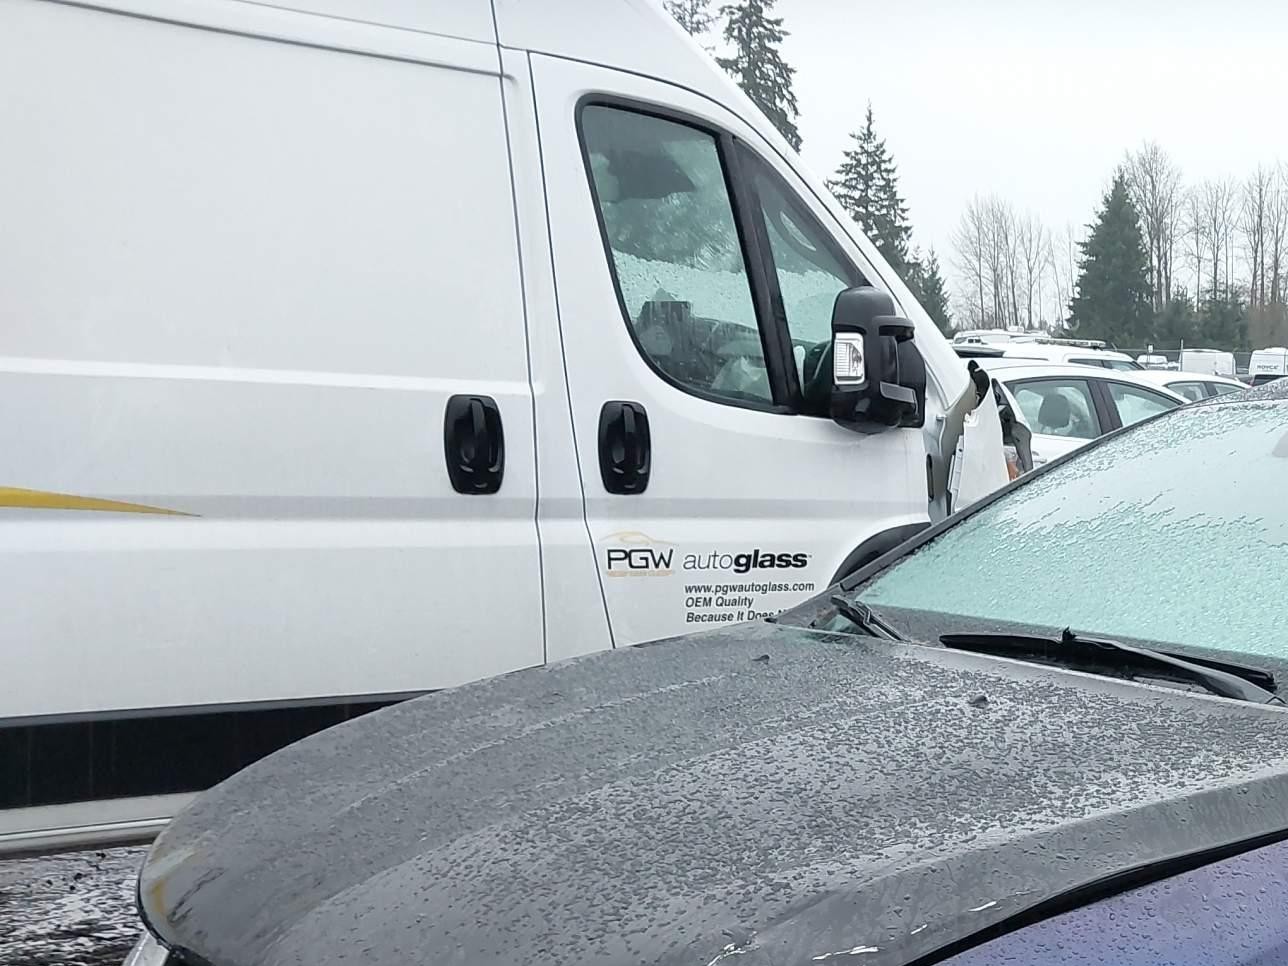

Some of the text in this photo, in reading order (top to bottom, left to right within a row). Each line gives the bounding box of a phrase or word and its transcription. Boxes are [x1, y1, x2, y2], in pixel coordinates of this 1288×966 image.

[607, 549, 809, 573] PGW autoglass
[685, 581, 814, 595] www.pgwautoglass.com
[685, 596, 754, 608] OEM Quality
[686, 612, 734, 623] Because
[737, 611, 744, 621] It
